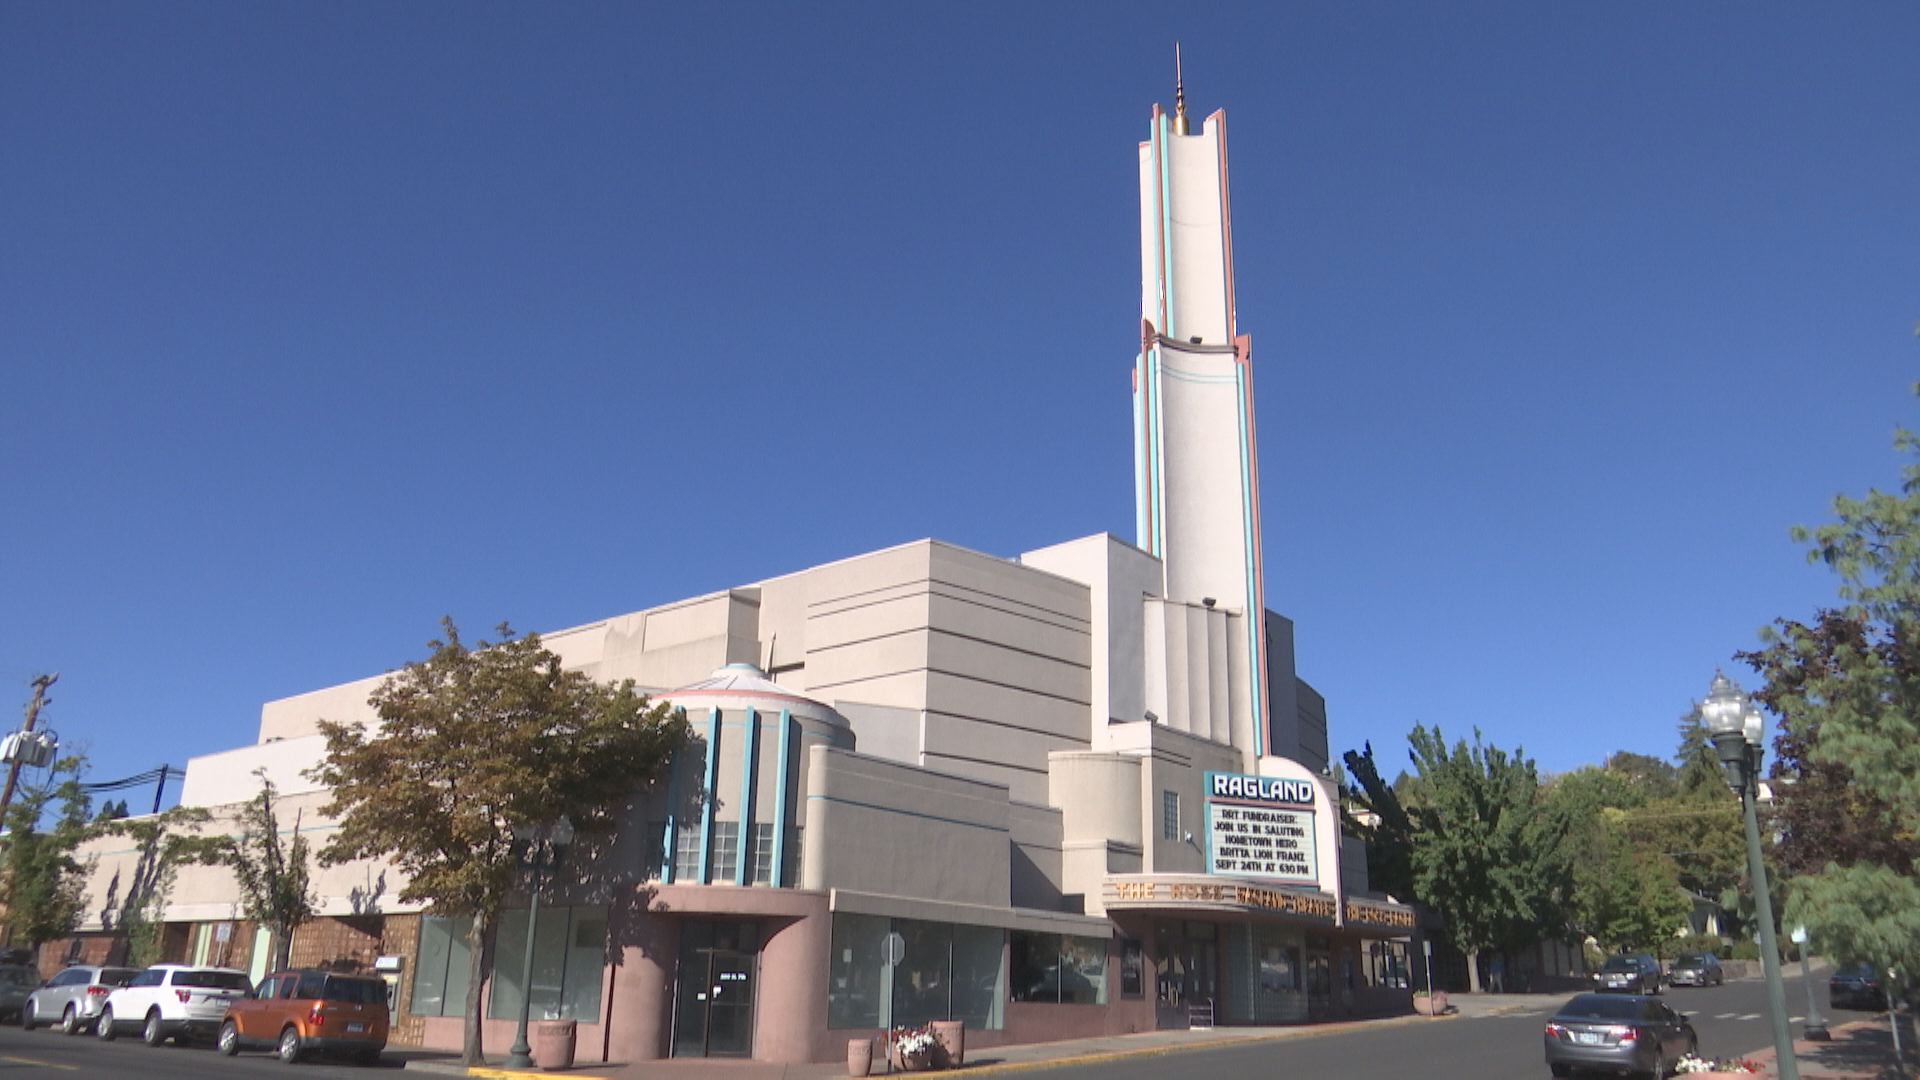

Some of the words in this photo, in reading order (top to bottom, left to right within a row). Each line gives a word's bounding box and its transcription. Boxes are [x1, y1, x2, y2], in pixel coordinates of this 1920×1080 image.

[1213, 774, 1313, 802] RAGLAND
[1215, 821, 1233, 832] JOIN
[1237, 823, 1248, 833] US
[1252, 824, 1261, 834] IN
[1265, 825, 1304, 838] SALUTING
[1225, 834, 1272, 847] HOMETOWN
[1275, 838, 1298, 849] HERO
[1220, 847, 1250, 858] BRITTA
[1254, 849, 1272, 860] LION
[1276, 851, 1305, 862] FRANZ
[1215, 859, 1236, 870] SEPT
[1241, 861, 1261, 872] 24TH
[1265, 862, 1275, 872] AT
[1296, 865, 1309, 875] PM
[1116, 882, 1155, 899] THE
